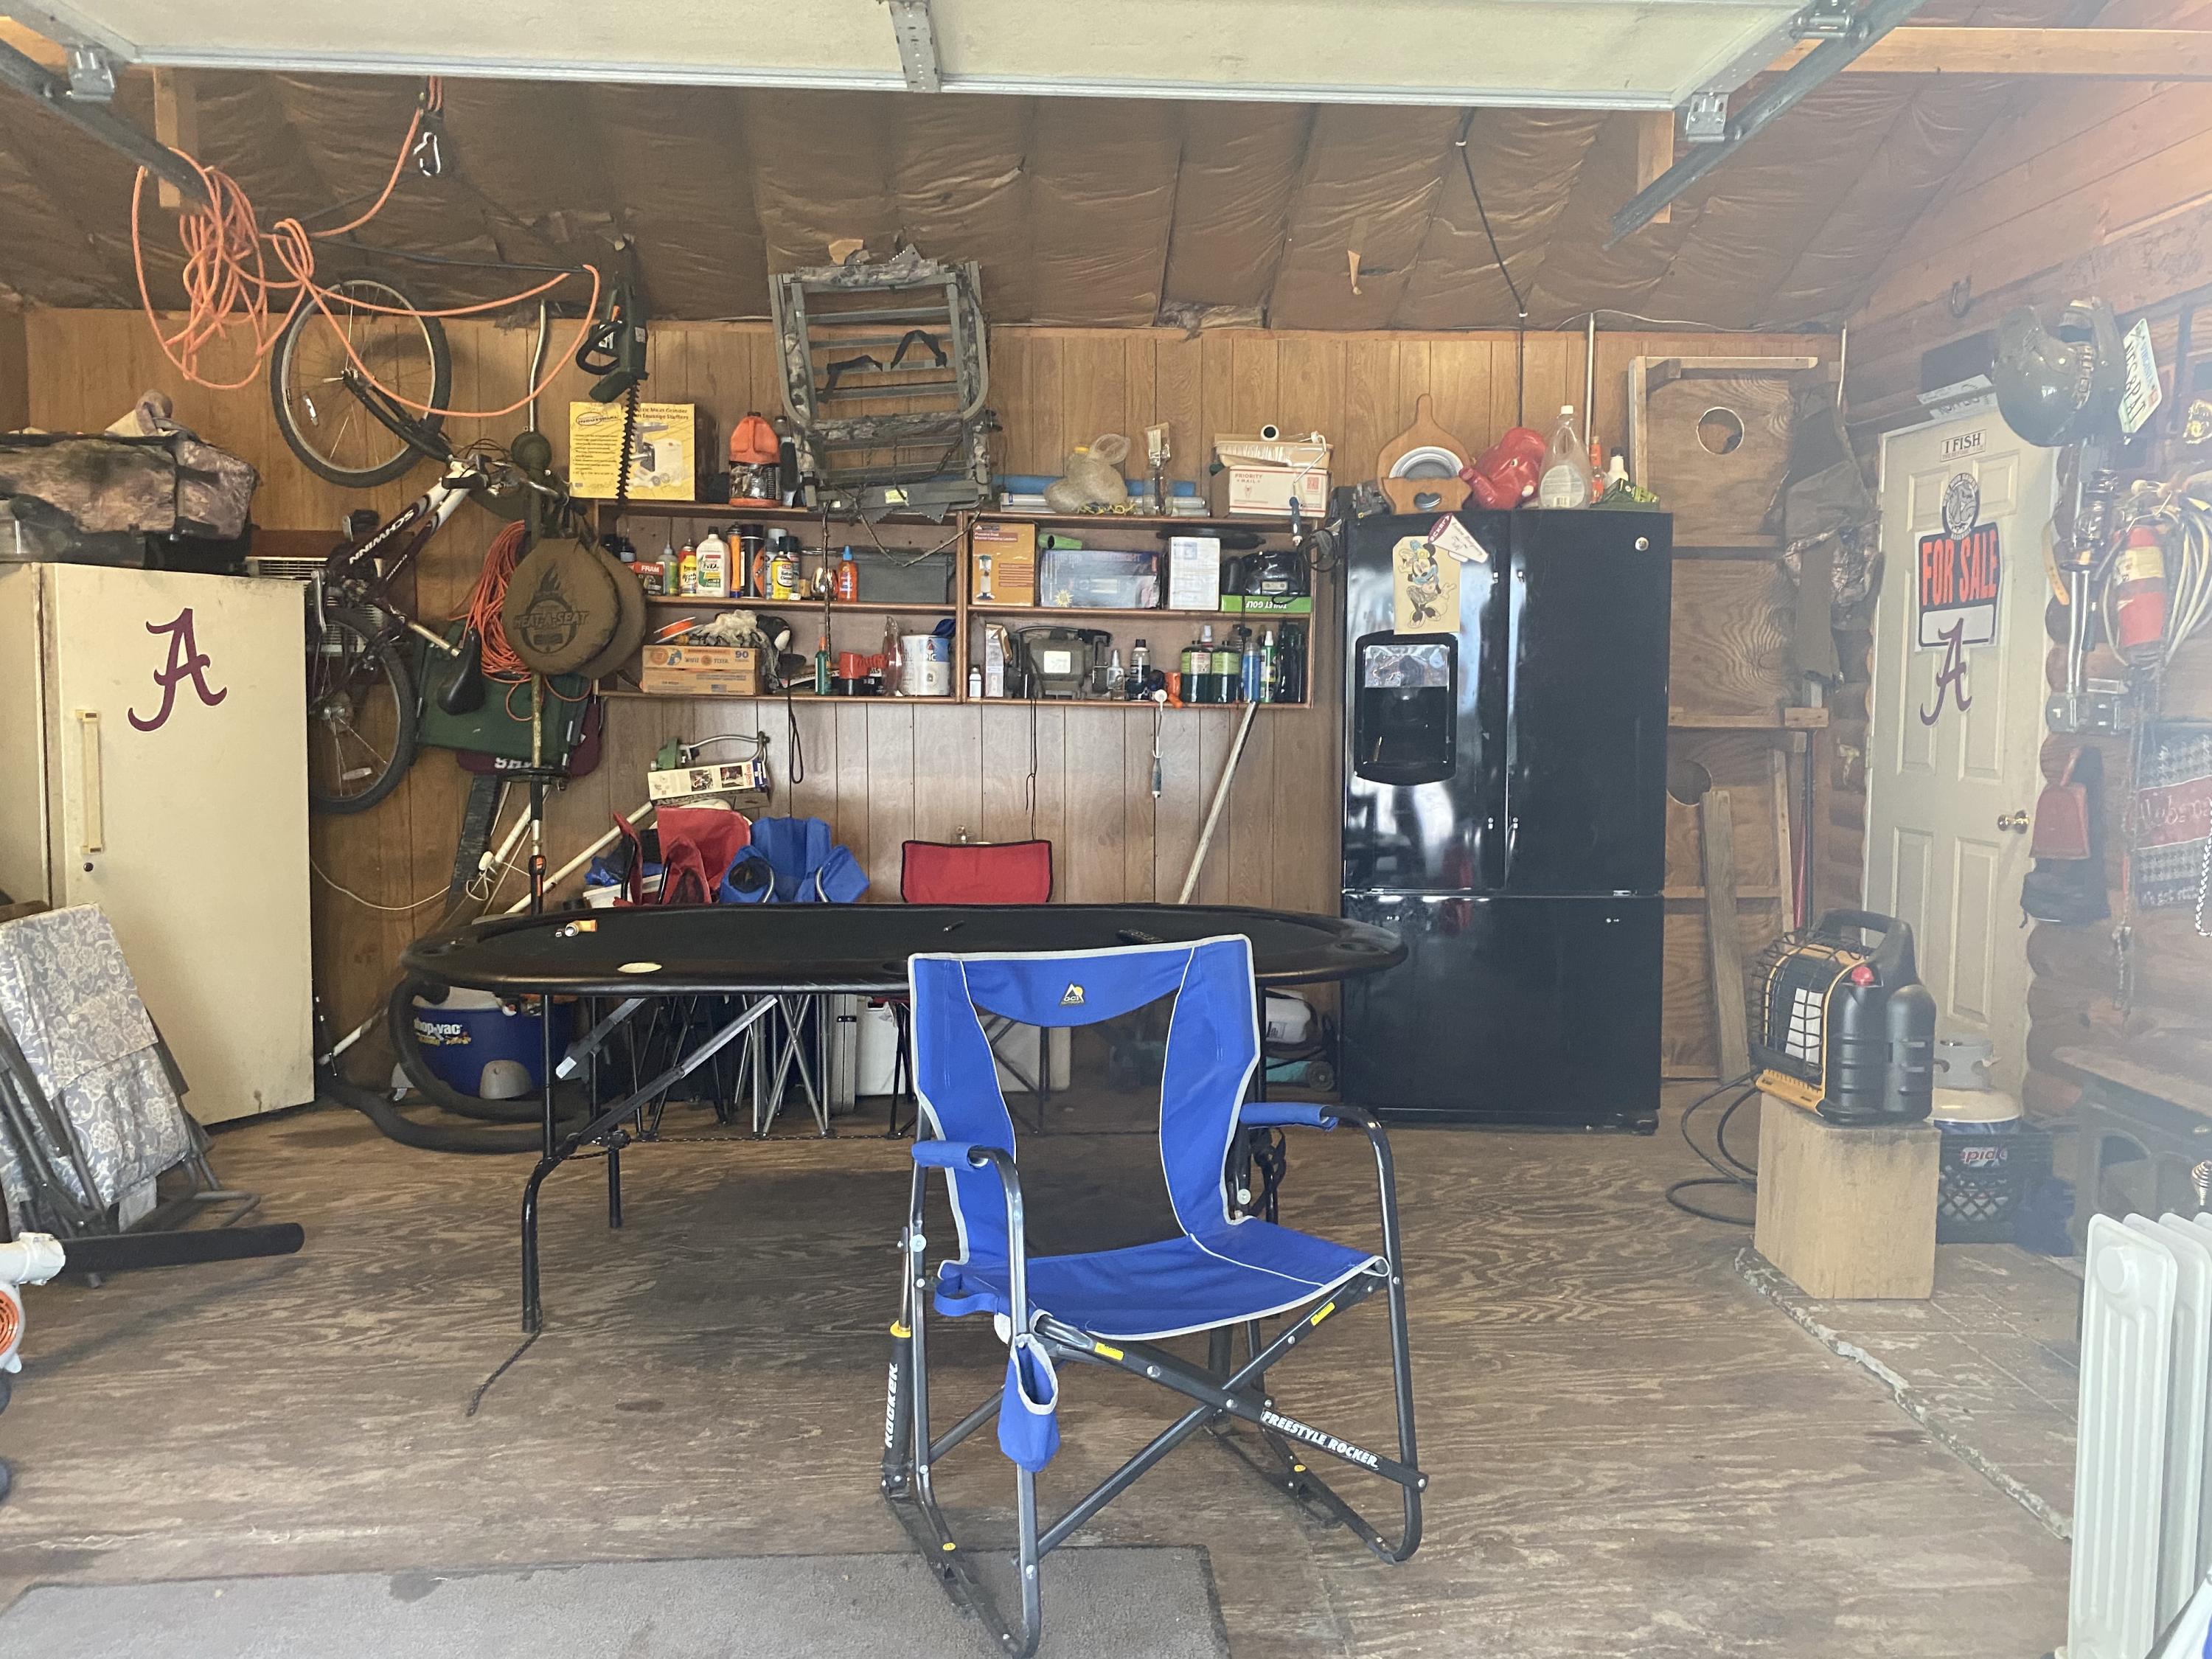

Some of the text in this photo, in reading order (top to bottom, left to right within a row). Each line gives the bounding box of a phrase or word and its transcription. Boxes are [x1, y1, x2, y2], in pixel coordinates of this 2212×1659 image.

[1945, 432, 1981, 453] I FISH
[349, 509, 414, 565] SCHWINN
[641, 565, 660, 573] FRAM
[1922, 529, 1997, 606] FOR SALE
[1246, 600, 1264, 609] GOLF
[735, 650, 749, 658] 90
[884, 1362, 898, 1449] ROCKER
[1262, 1411, 1380, 1470] FREESTYLE ROCKER
